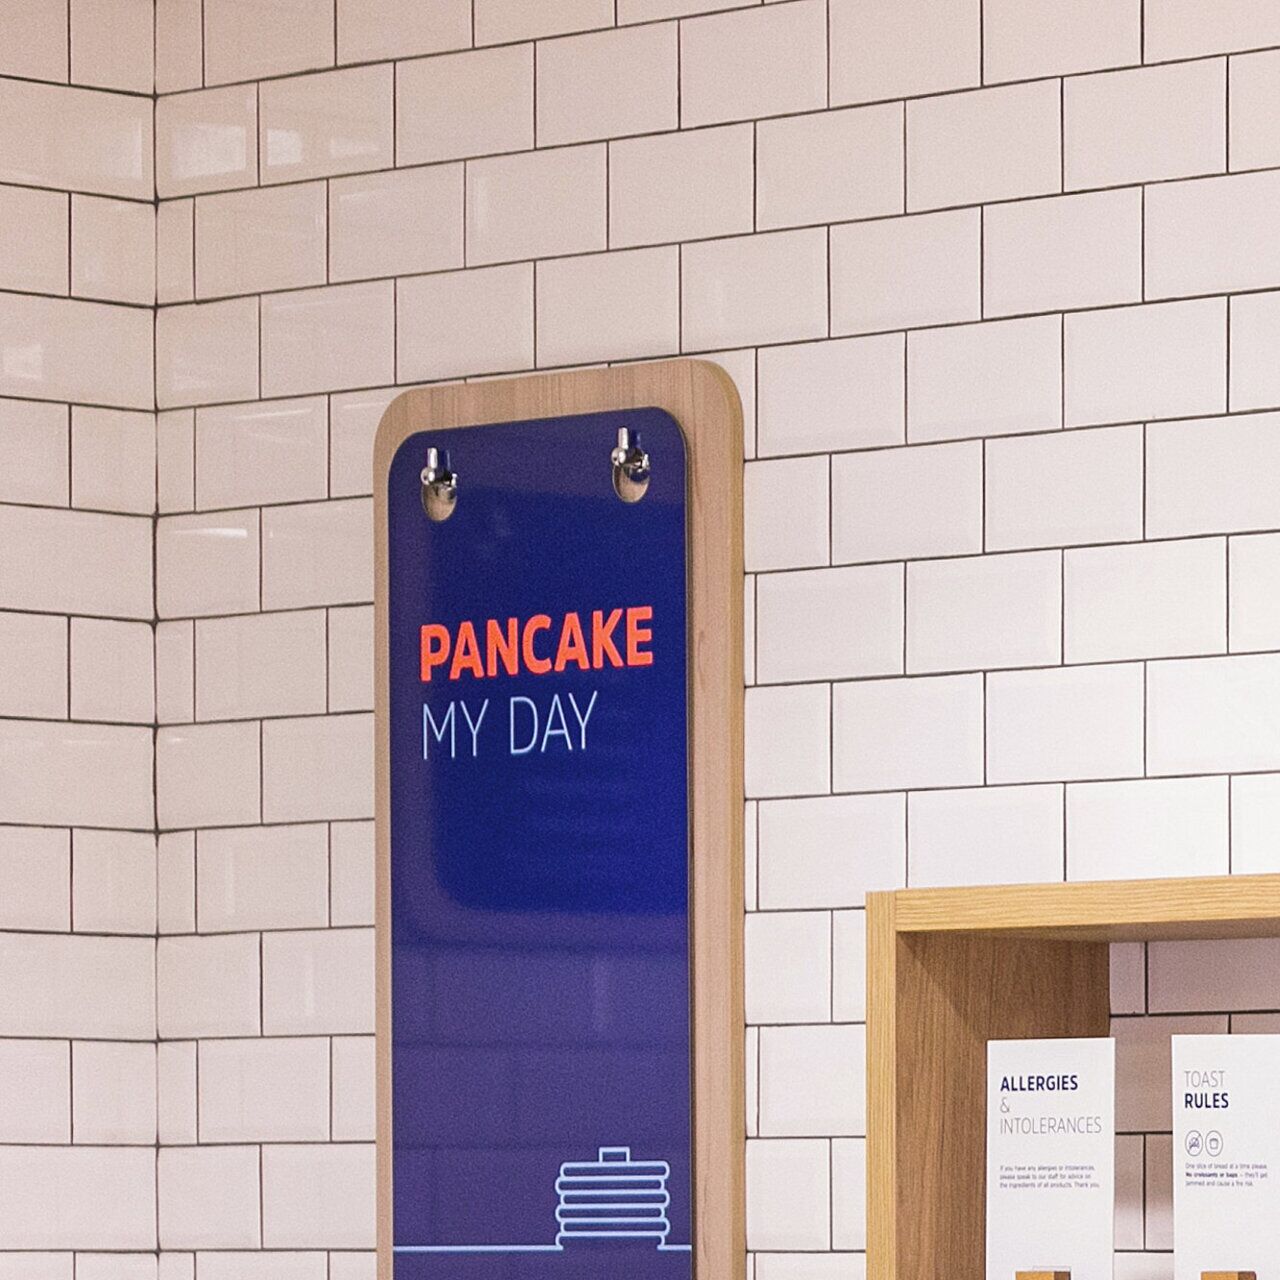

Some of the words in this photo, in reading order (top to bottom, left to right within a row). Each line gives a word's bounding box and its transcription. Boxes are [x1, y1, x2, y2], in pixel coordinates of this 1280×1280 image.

[420, 605, 653, 682] PANCAKE
[423, 698, 489, 760] MY
[510, 690, 598, 755] DAY
[1000, 1075, 1078, 1091] ALLERGIES
[1184, 1070, 1225, 1088] TOAST
[1000, 1097, 1010, 1113] &
[1185, 1092, 1229, 1109] RULES
[1000, 1116, 1102, 1134] INTOLERANCES
